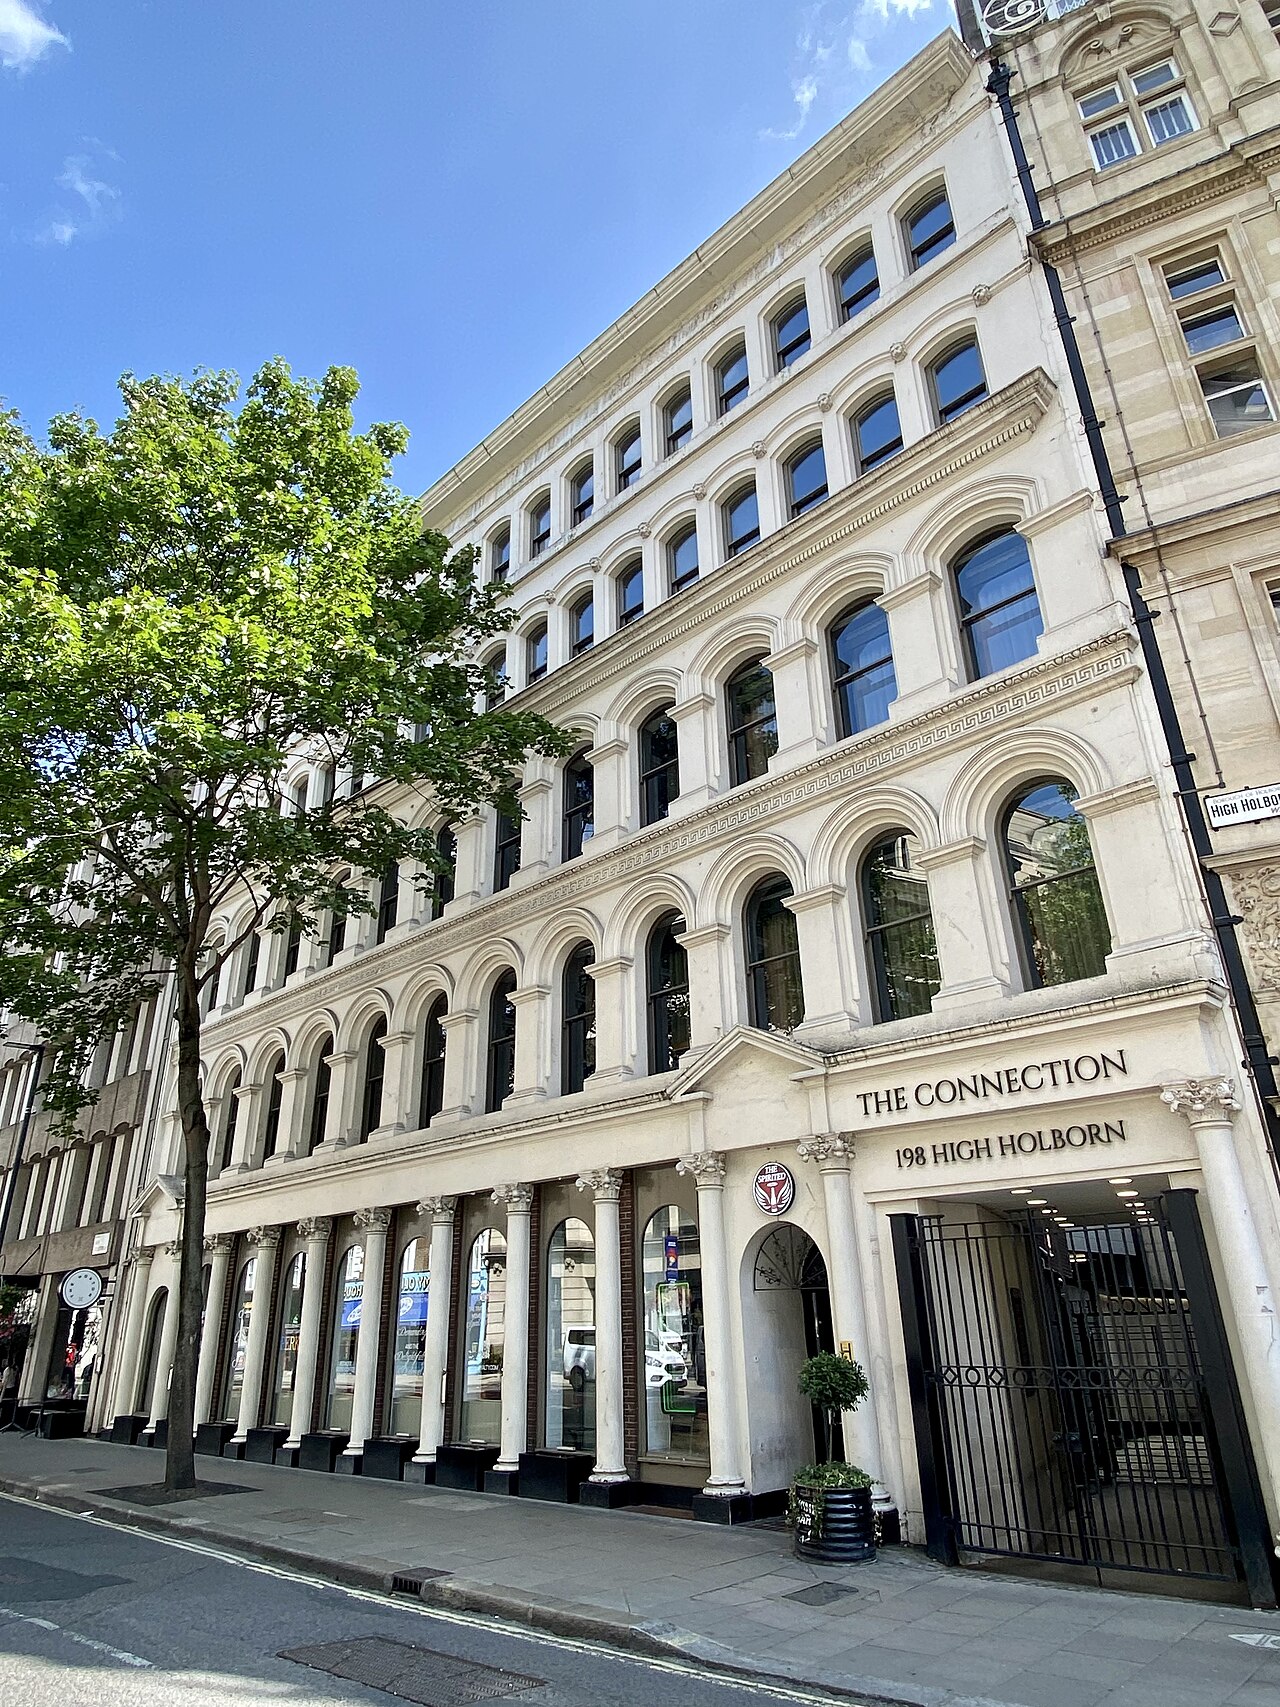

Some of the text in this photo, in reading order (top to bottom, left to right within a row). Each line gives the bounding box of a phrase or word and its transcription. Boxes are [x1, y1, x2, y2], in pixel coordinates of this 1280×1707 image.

[1211, 794, 1280, 818] HIGH HOLBO
[856, 1049, 1128, 1116] THE CONNECTION
[896, 1120, 1127, 1168] 198 HIGH HOLBORN
[757, 1172, 786, 1183] SPIRITED
[765, 1166, 778, 1174] THE
